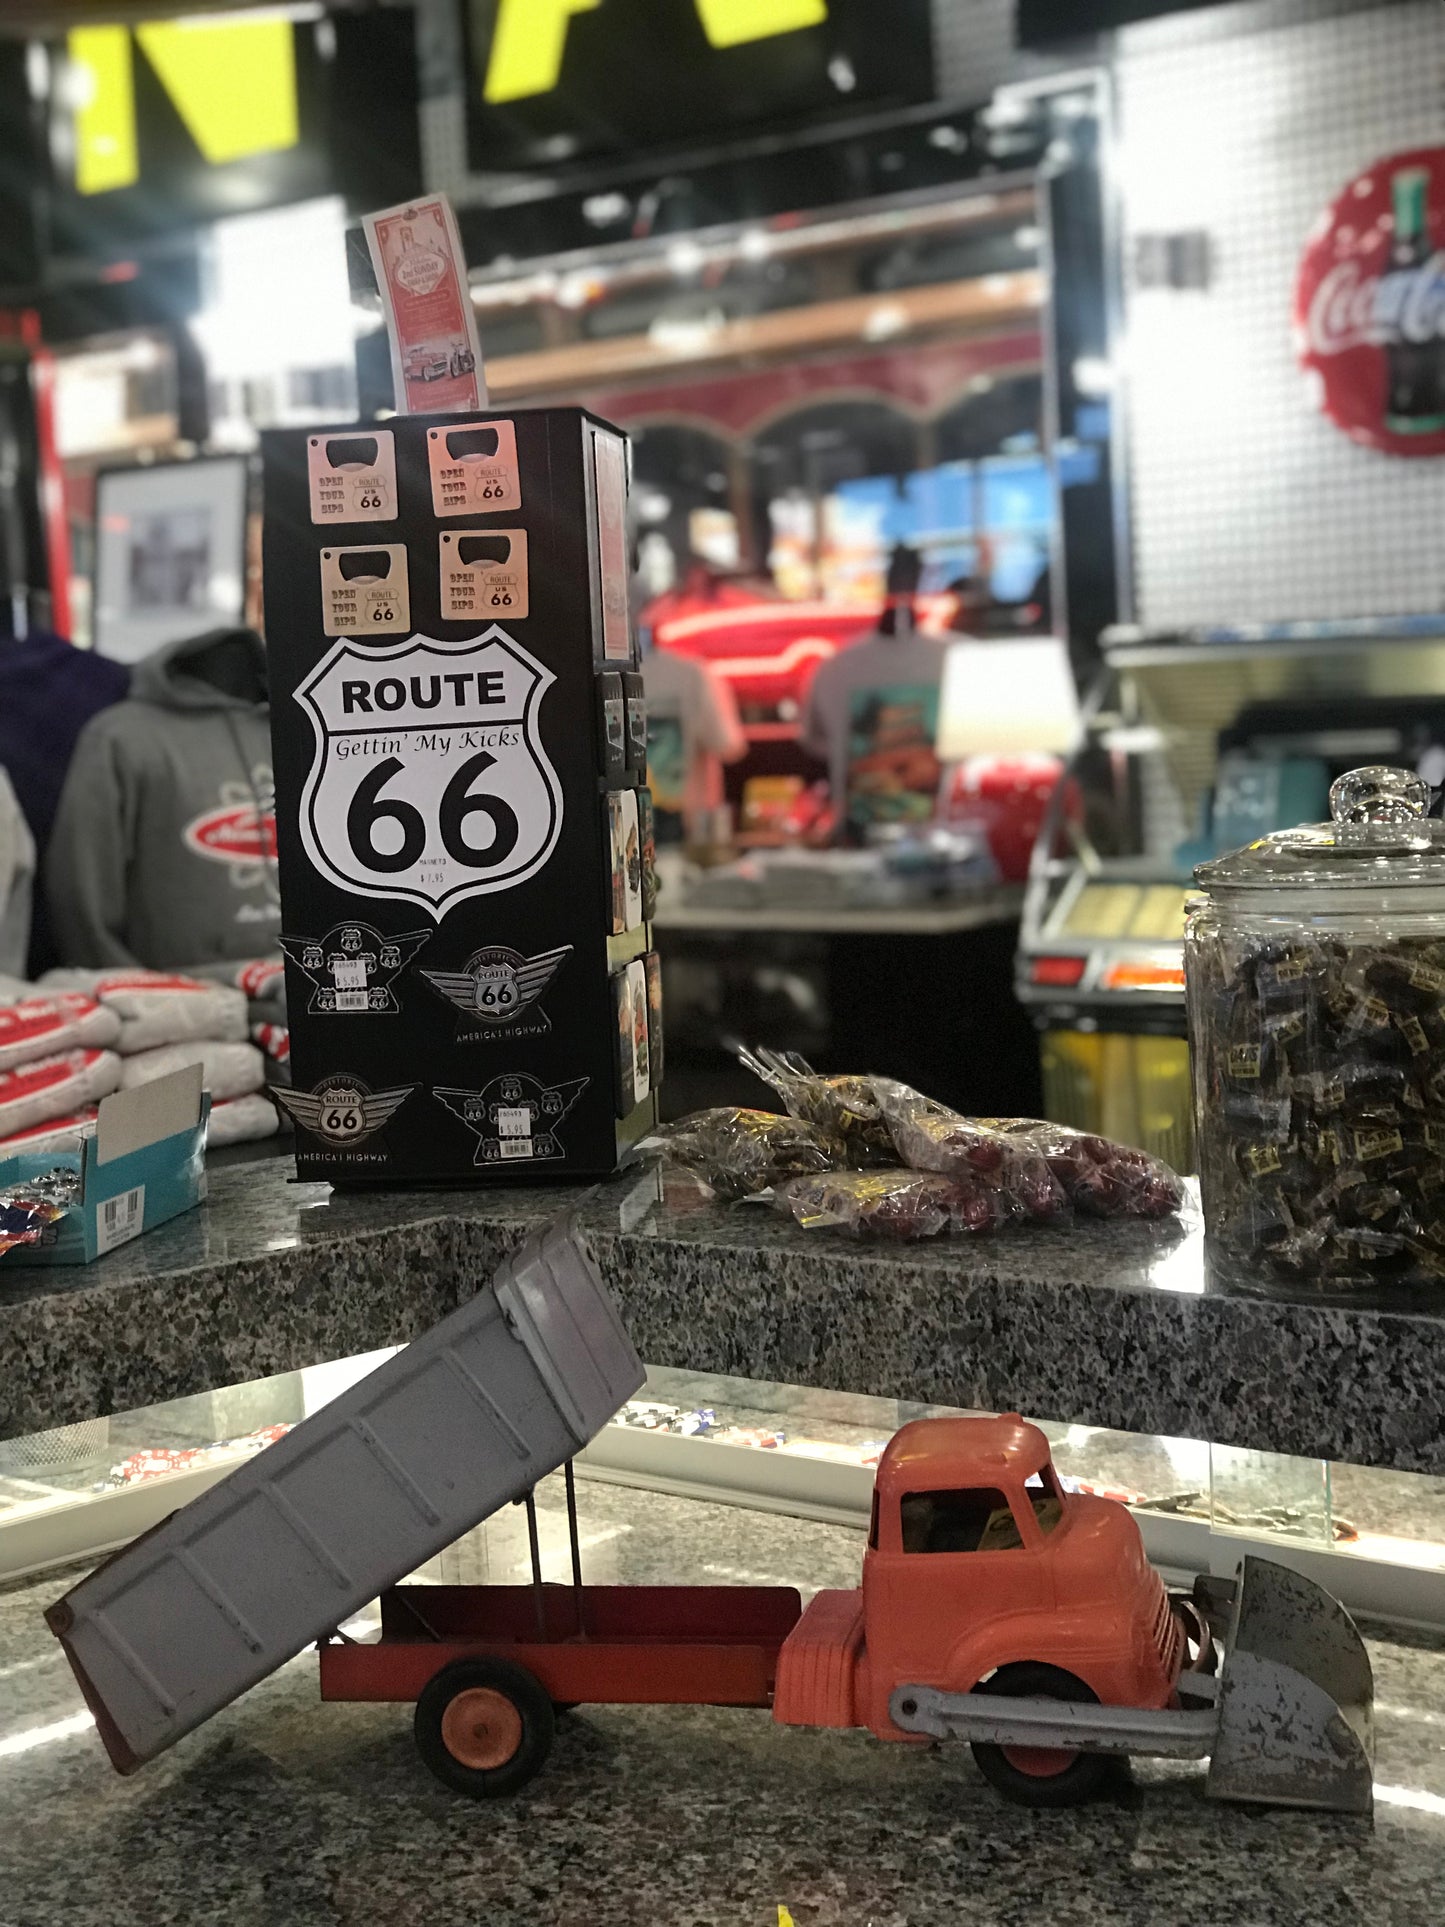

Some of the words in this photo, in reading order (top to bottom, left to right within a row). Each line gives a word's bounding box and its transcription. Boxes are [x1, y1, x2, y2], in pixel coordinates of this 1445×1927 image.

[480, 468, 502, 477] ROUTE
[482, 485, 504, 499] 66
[361, 496, 381, 508] 66
[371, 591, 392, 599] ROUTE
[491, 593, 512, 606] 66
[373, 608, 394, 621] 66
[341, 671, 506, 713] ROUTE
[336, 734, 409, 760] Gettin'
[414, 733, 451, 756] My
[459, 727, 520, 749] Kicks
[347, 750, 519, 874] 66
[478, 970, 509, 979] ROUTE
[343, 976, 359, 986] 5.95
[482, 984, 512, 1005] 66
[505, 1025, 547, 1035] HIGHWAY
[326, 1096, 357, 1104] ROUTE
[327, 1110, 357, 1129] 66
[507, 1124, 523, 1134] 5.95
